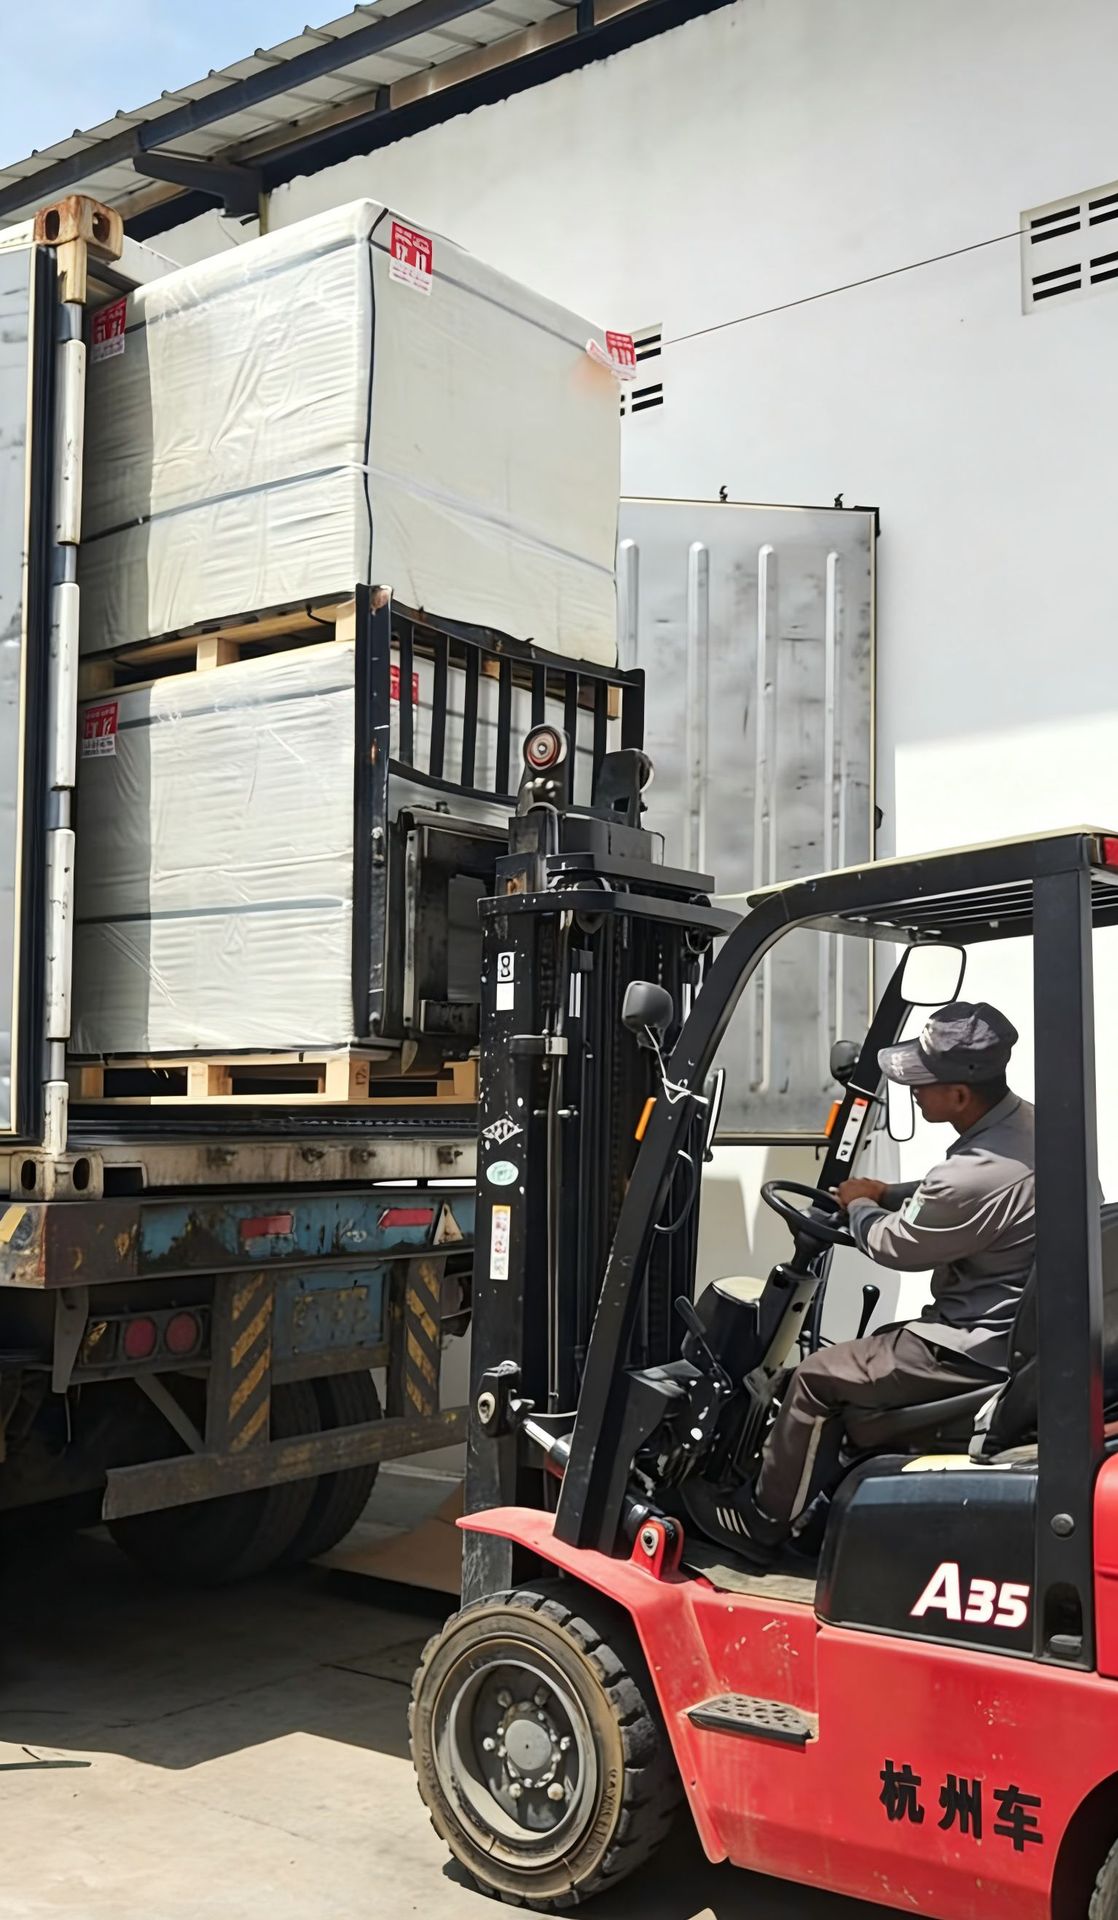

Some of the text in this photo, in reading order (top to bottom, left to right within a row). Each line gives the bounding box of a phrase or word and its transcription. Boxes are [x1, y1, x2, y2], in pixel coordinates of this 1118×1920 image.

[909, 1561, 1030, 1628] A35
[879, 1758, 1044, 1853] 杭州车
